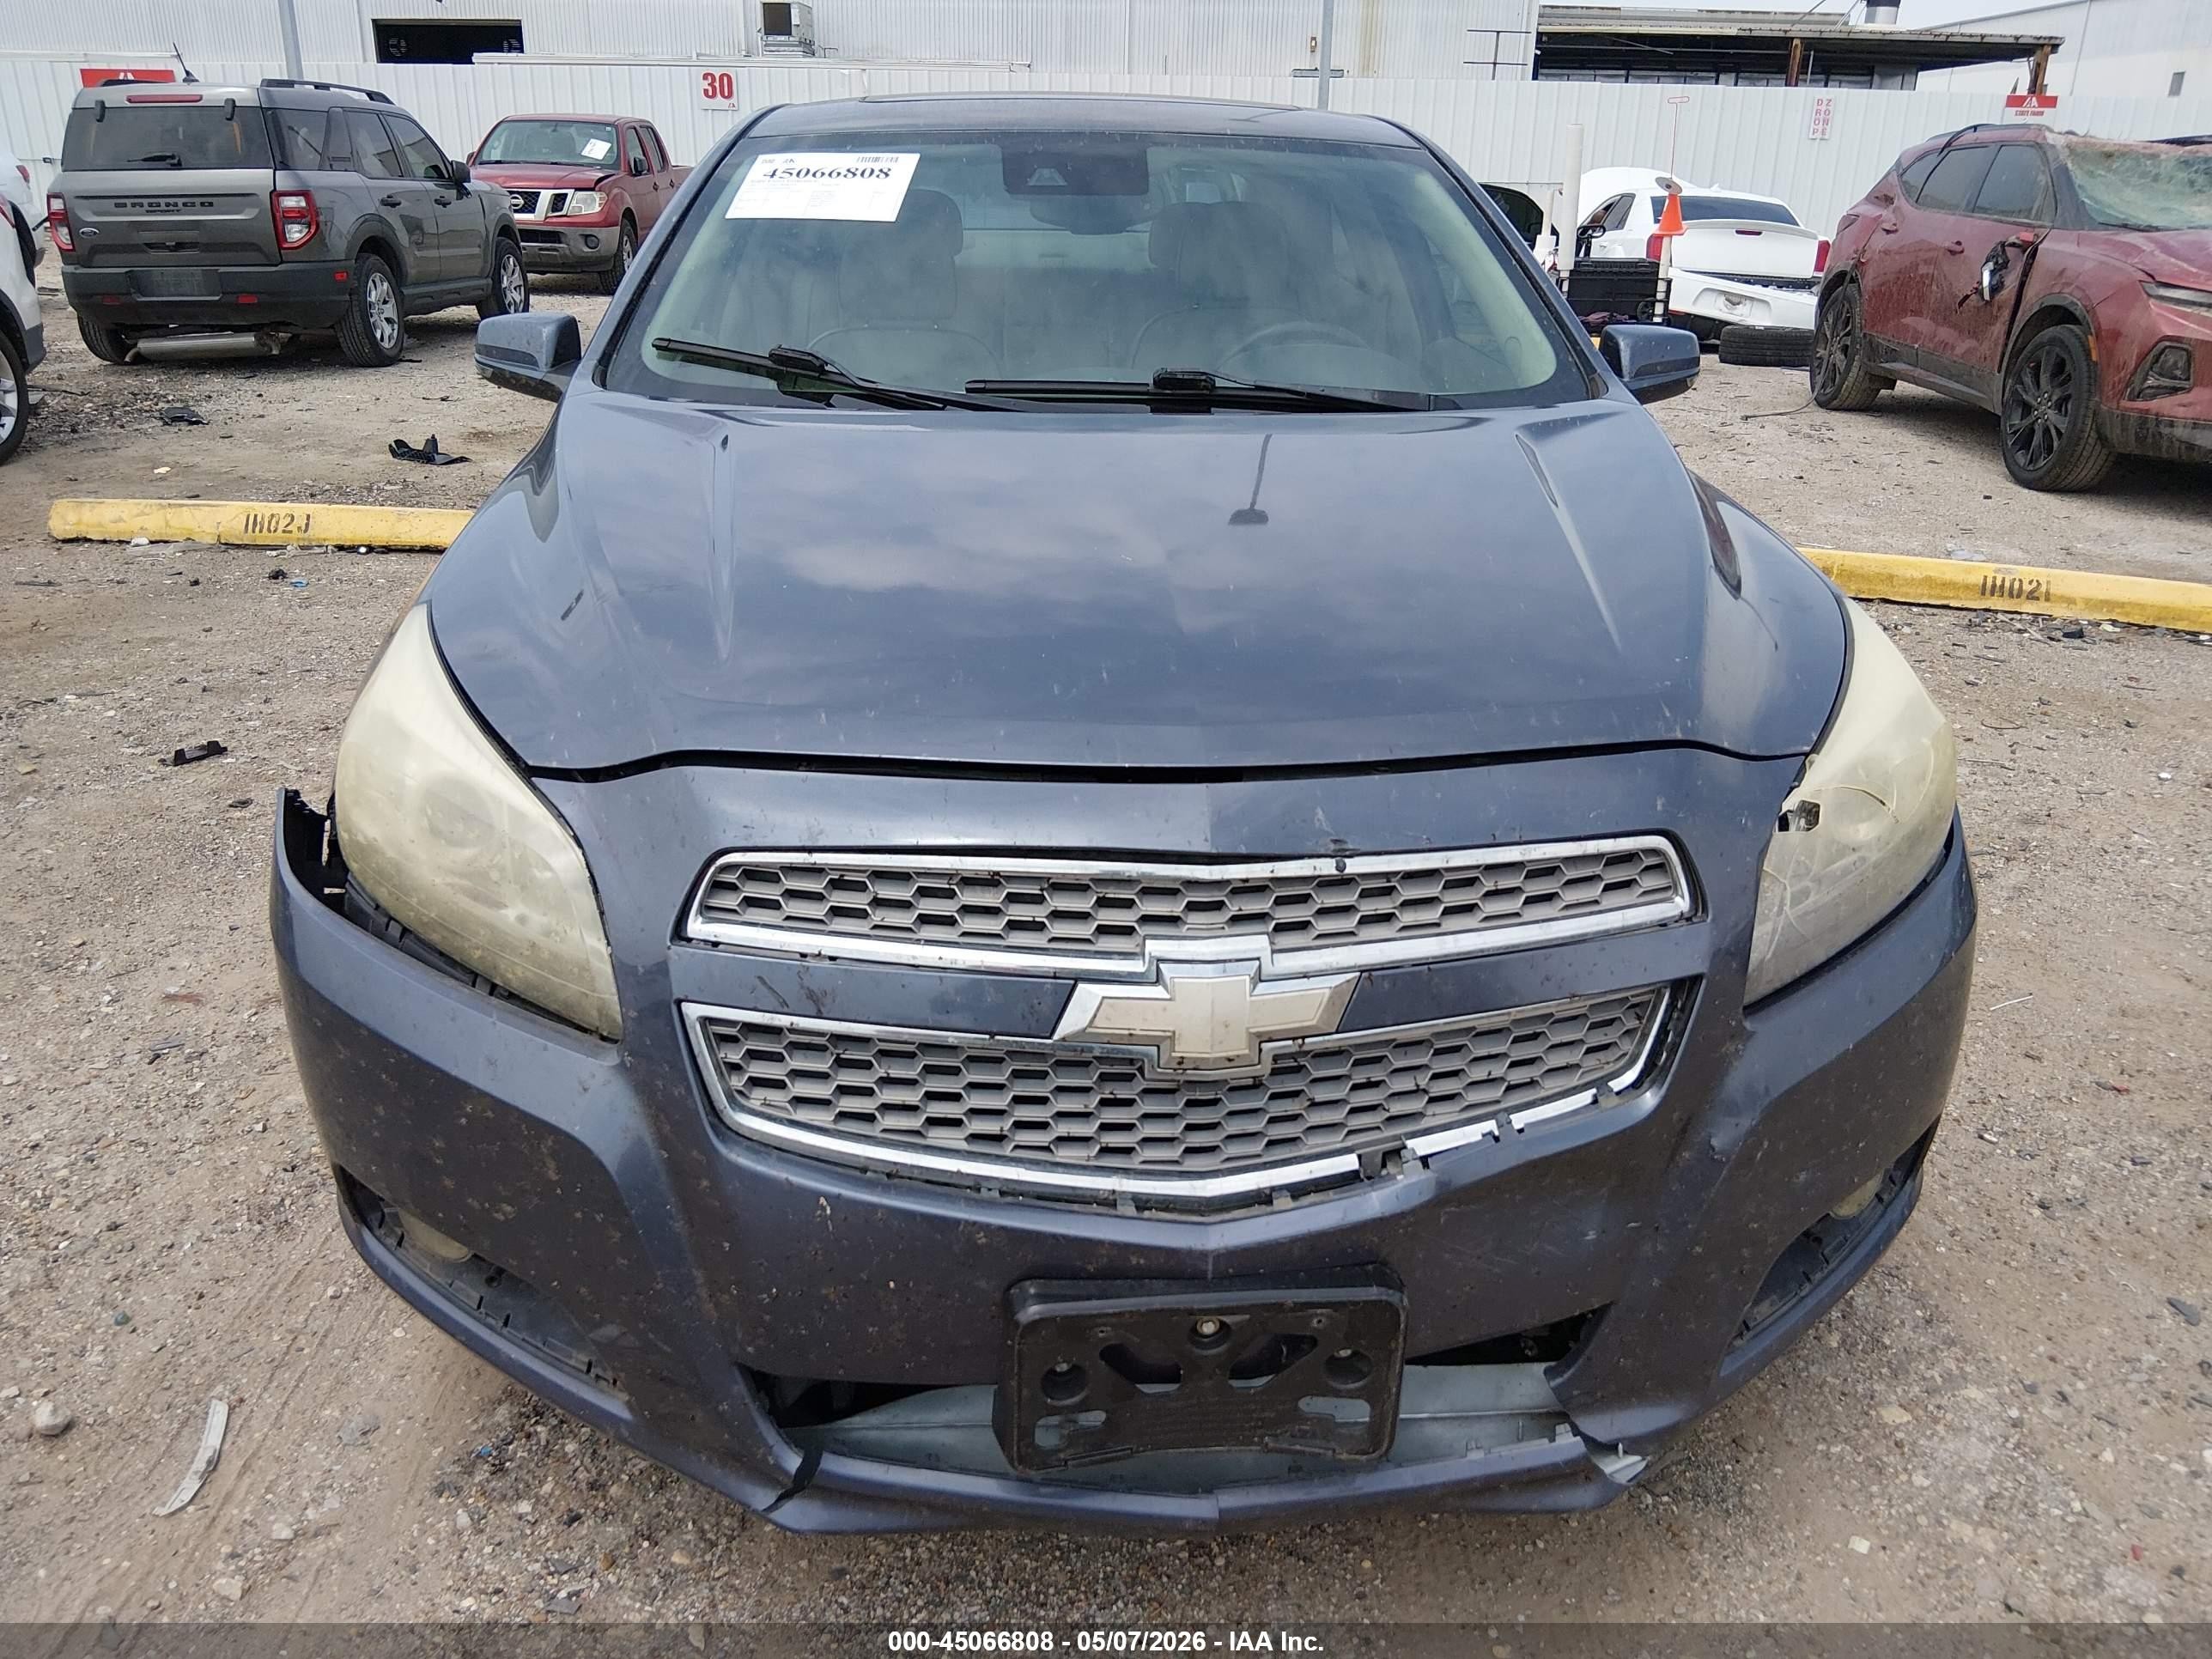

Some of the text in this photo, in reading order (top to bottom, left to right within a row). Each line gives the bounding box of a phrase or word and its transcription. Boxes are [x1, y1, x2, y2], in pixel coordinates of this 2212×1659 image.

[702, 72, 733, 100] 30
[763, 167, 892, 179] 45066808
[113, 200, 214, 209] BRONCO
